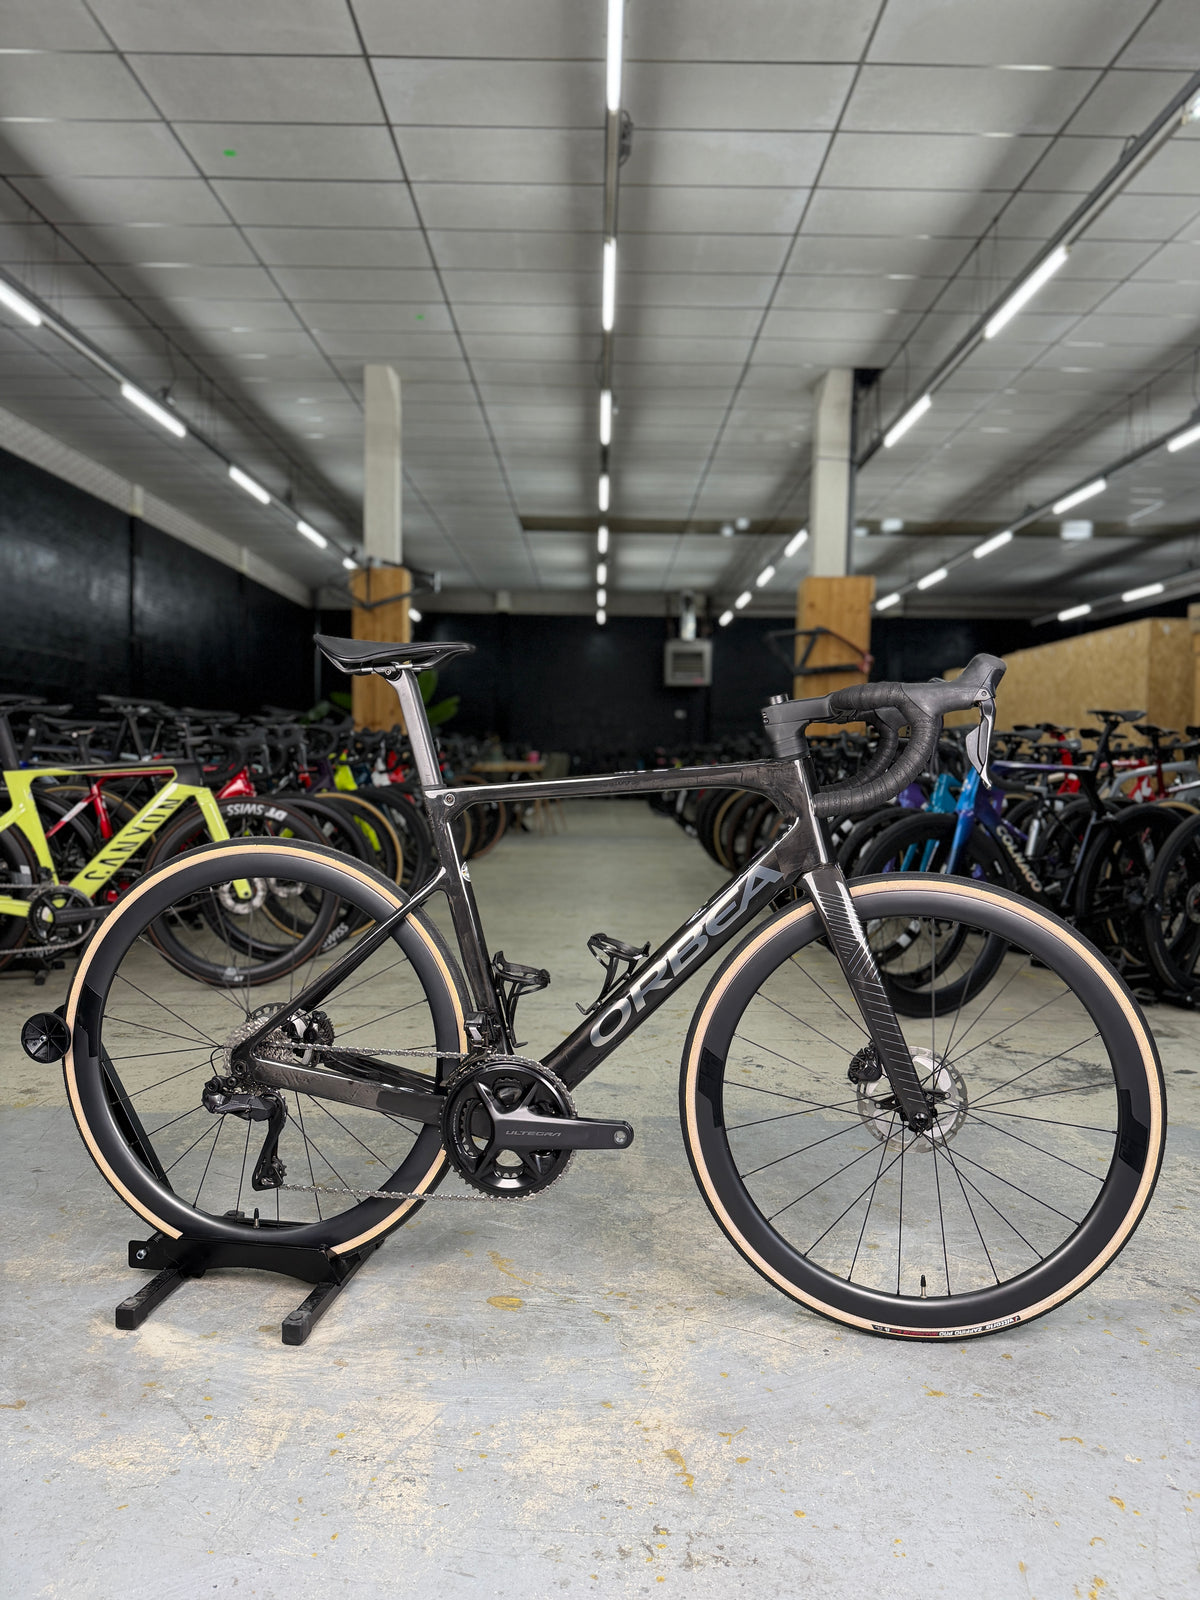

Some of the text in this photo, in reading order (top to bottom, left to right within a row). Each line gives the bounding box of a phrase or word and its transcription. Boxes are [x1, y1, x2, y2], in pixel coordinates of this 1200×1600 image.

[84, 796, 181, 881] CANYON
[226, 803, 288, 822] DT SWISS
[996, 825, 1043, 893] COLNAGO
[589, 866, 784, 1048] ORBEA
[505, 1129, 562, 1138] ULTEGRA
